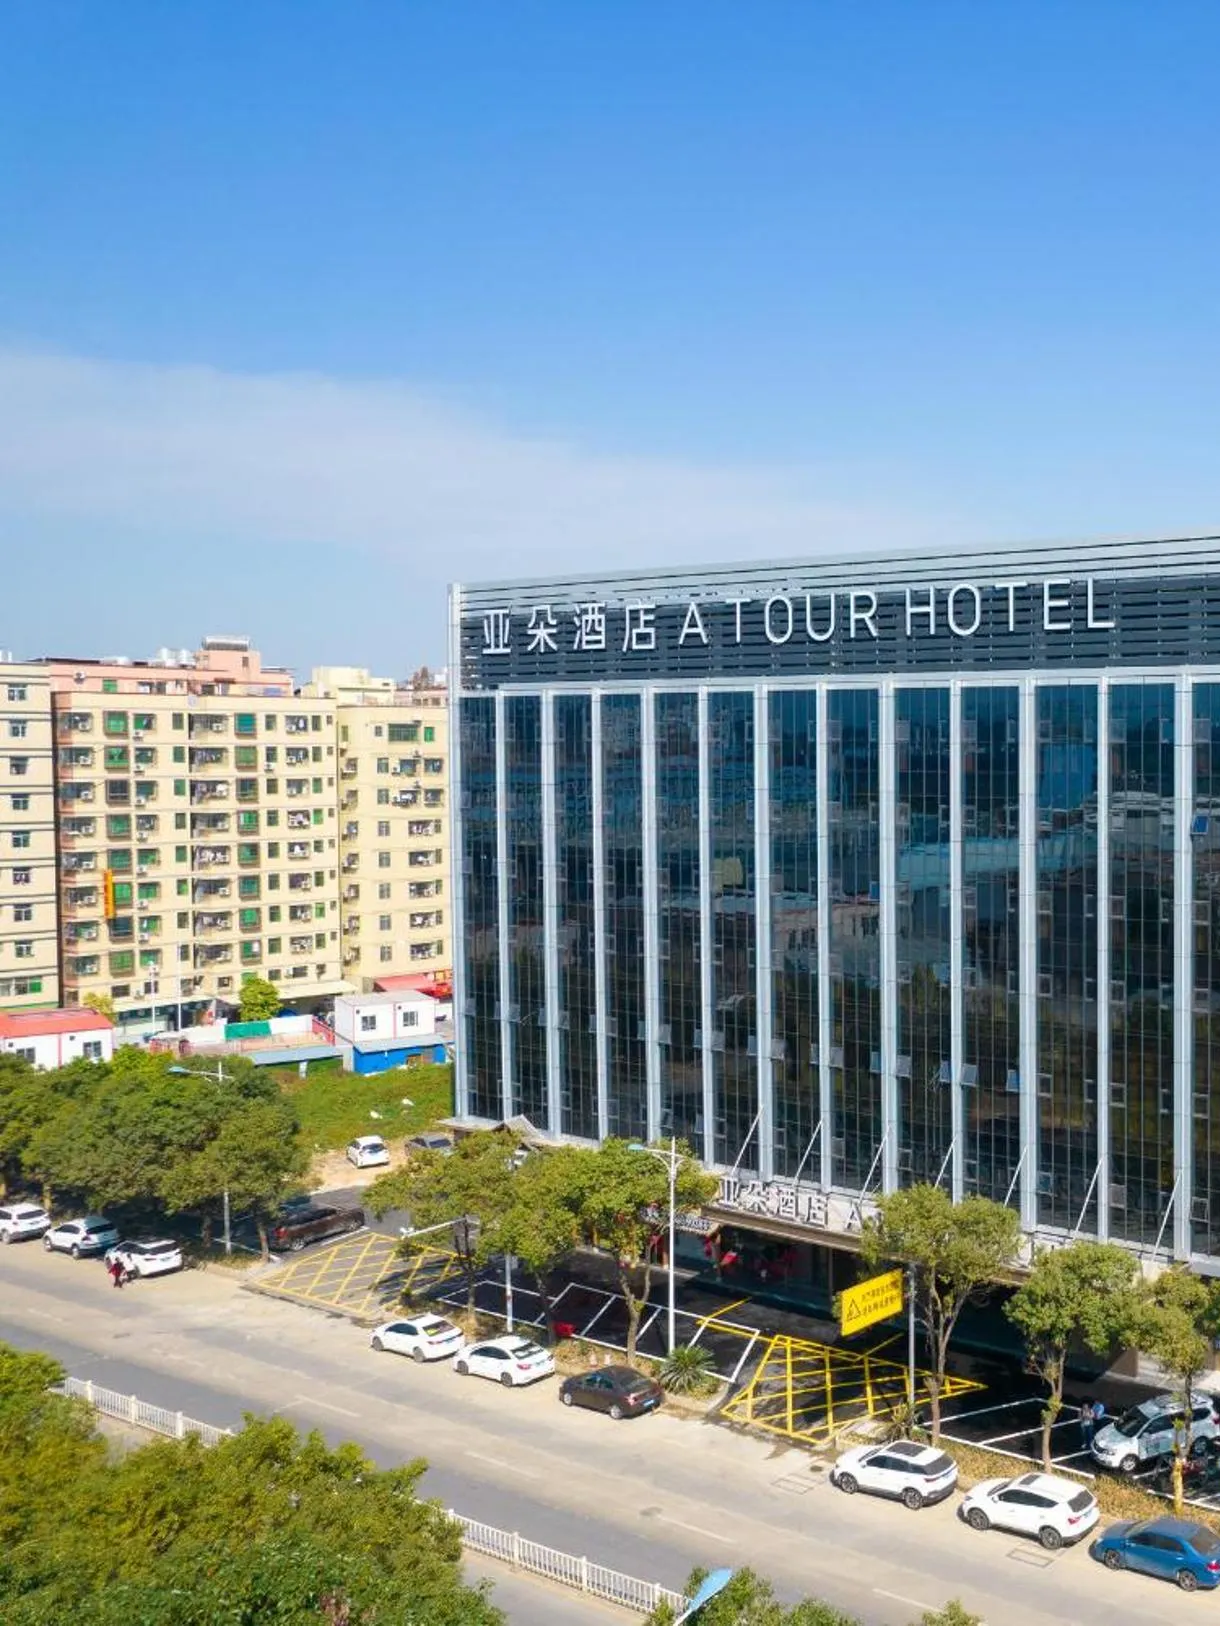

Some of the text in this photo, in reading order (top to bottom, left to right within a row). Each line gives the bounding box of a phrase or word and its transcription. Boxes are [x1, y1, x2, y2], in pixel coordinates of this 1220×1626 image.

[482, 577, 1116, 654] 亚朵酒店 ATOUR HOTEL
[718, 1176, 828, 1230] 亚朵酒店
